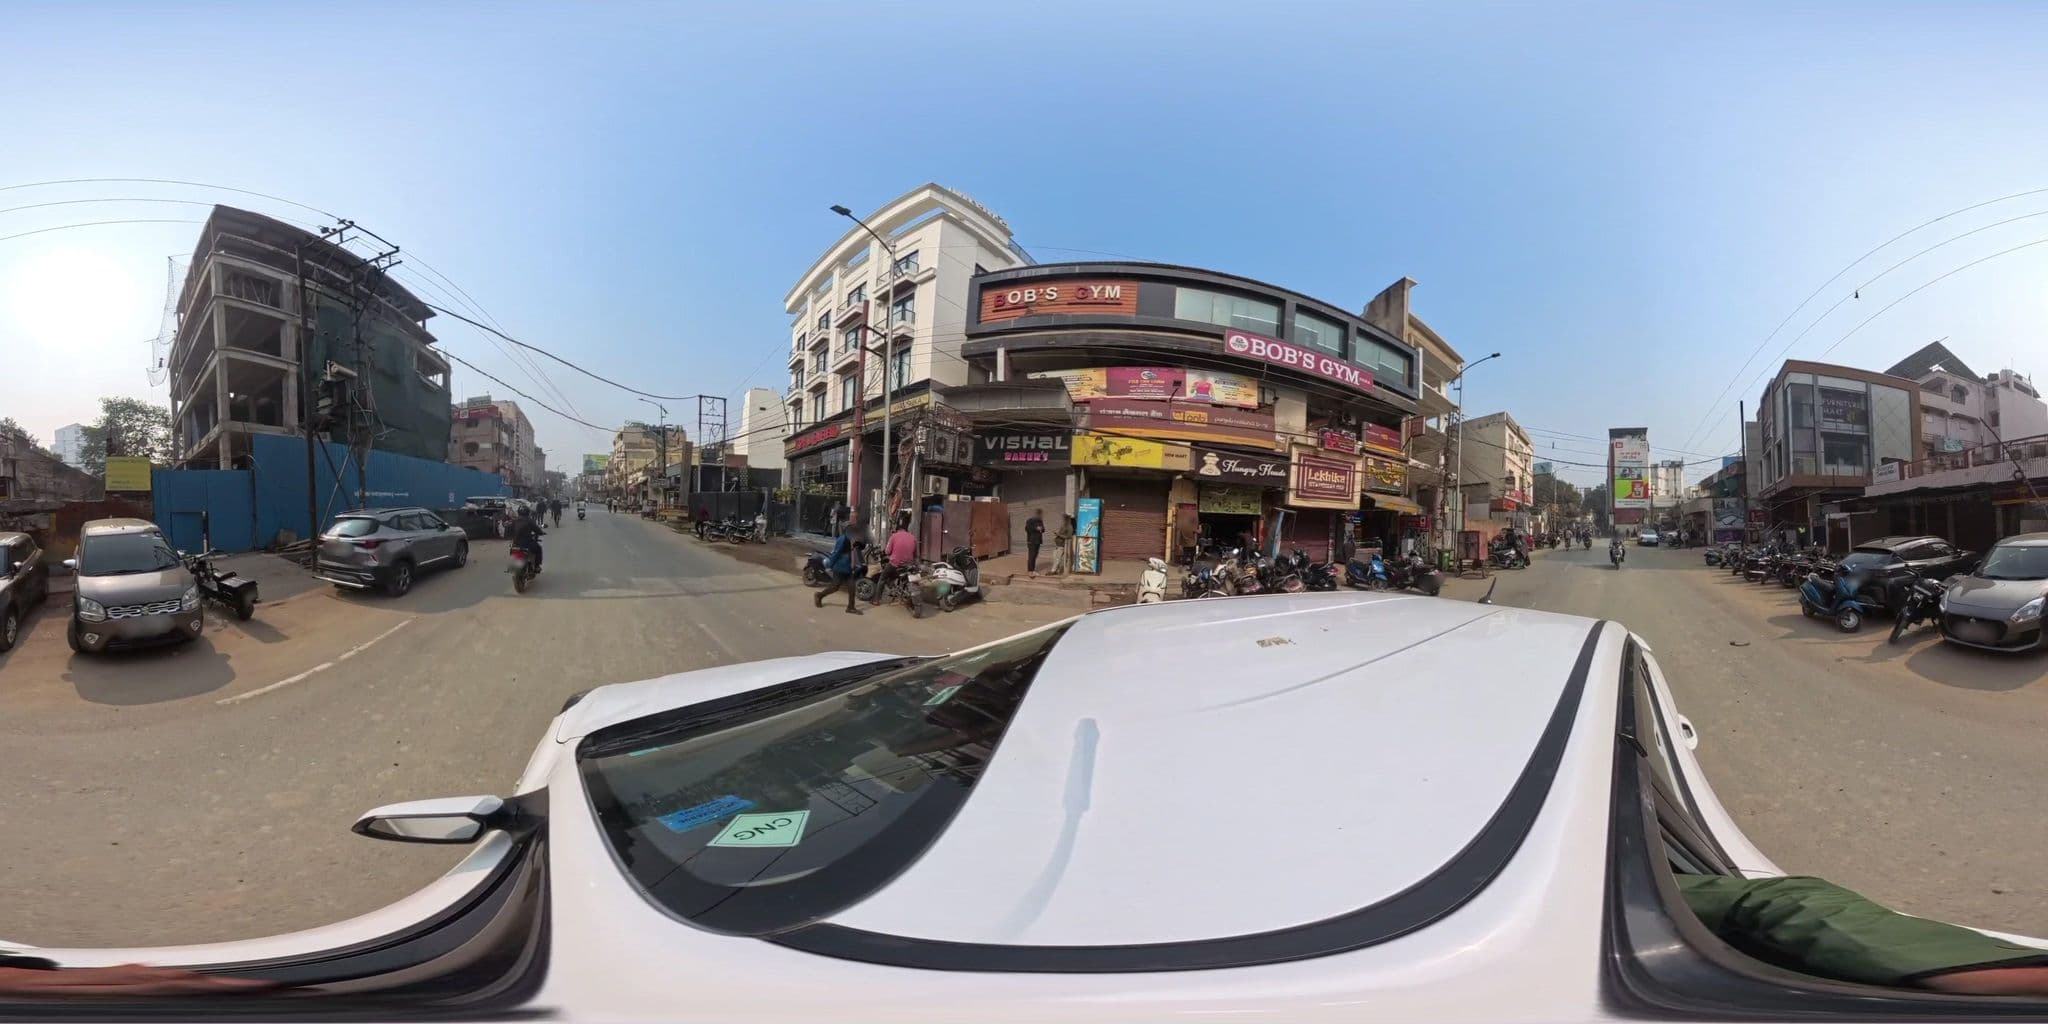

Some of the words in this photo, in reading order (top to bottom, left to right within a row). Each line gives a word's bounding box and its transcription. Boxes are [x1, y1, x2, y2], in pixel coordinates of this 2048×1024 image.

[993, 286, 1058, 308] BOB'S
[1074, 285, 1122, 300] GYM
[1250, 338, 1315, 370] BOB'S
[1320, 359, 1361, 386] GYM
[1222, 459, 1258, 477] Hungry
[733, 817, 792, 841] CNG
